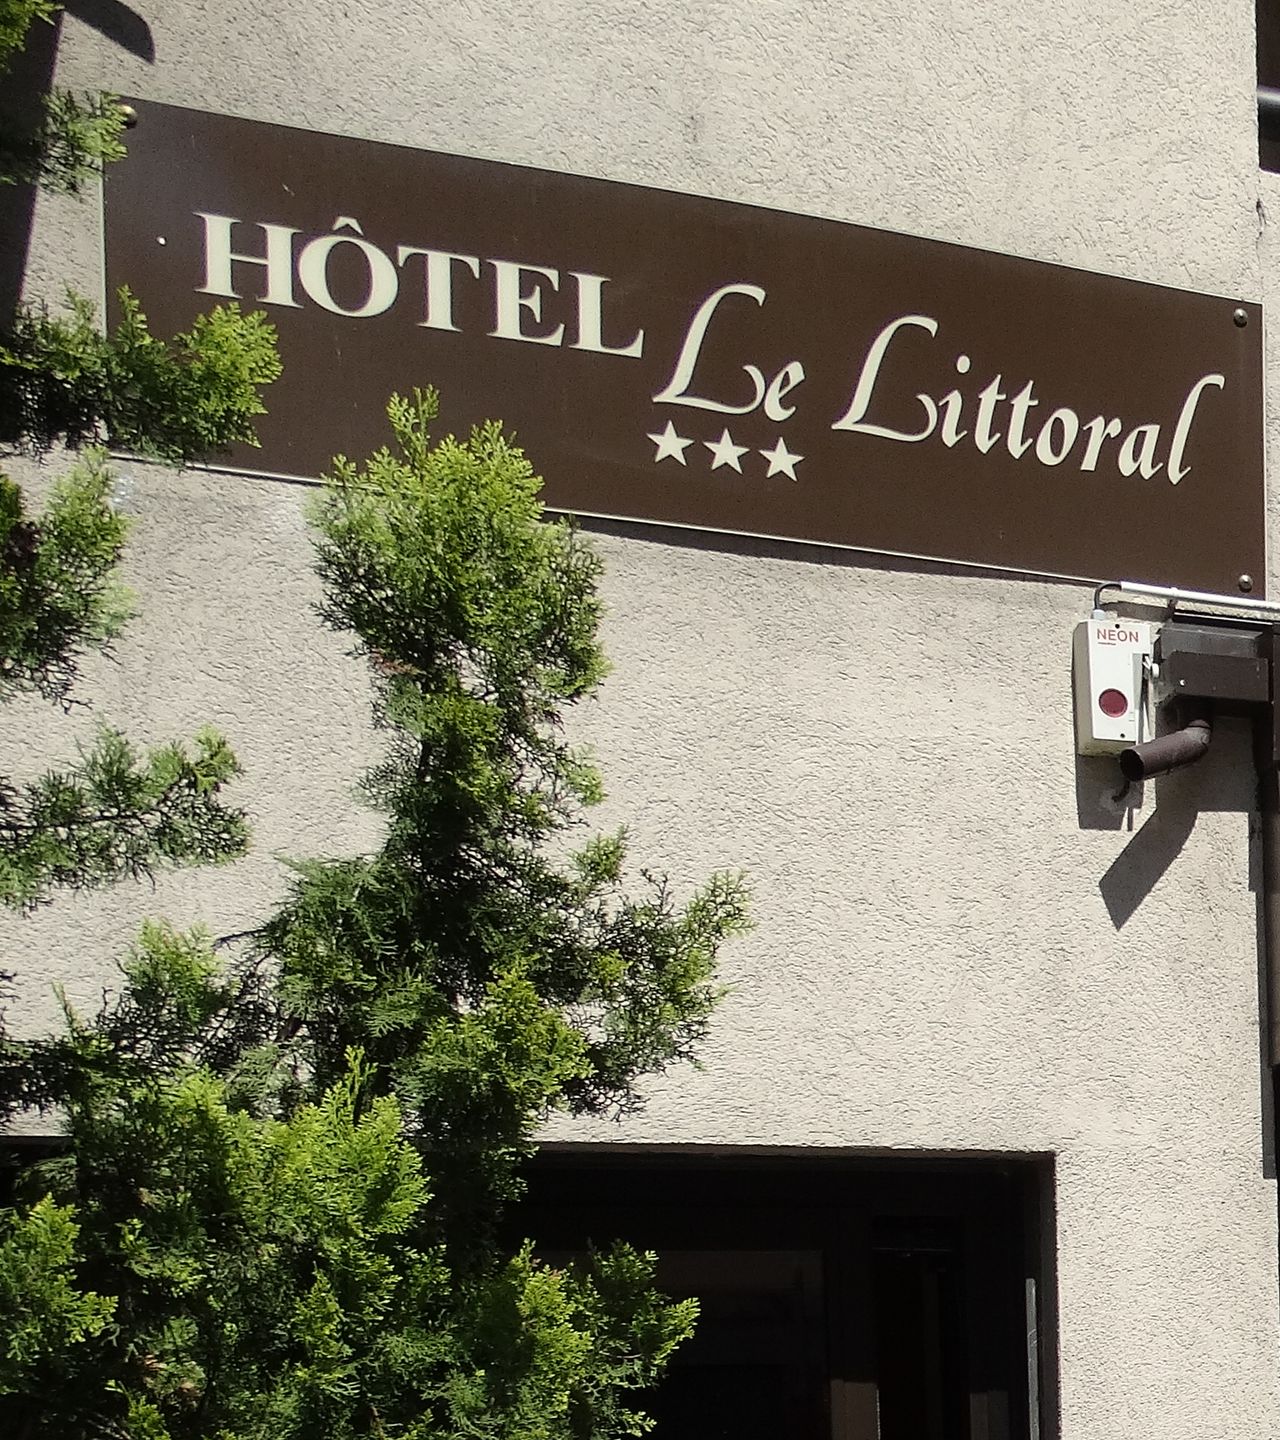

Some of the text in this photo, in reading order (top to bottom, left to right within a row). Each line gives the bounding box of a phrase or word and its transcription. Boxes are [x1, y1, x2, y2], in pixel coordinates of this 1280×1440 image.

[195, 212, 1225, 485] HÔTEL Le Littoral
[1097, 629, 1139, 643] NEON
